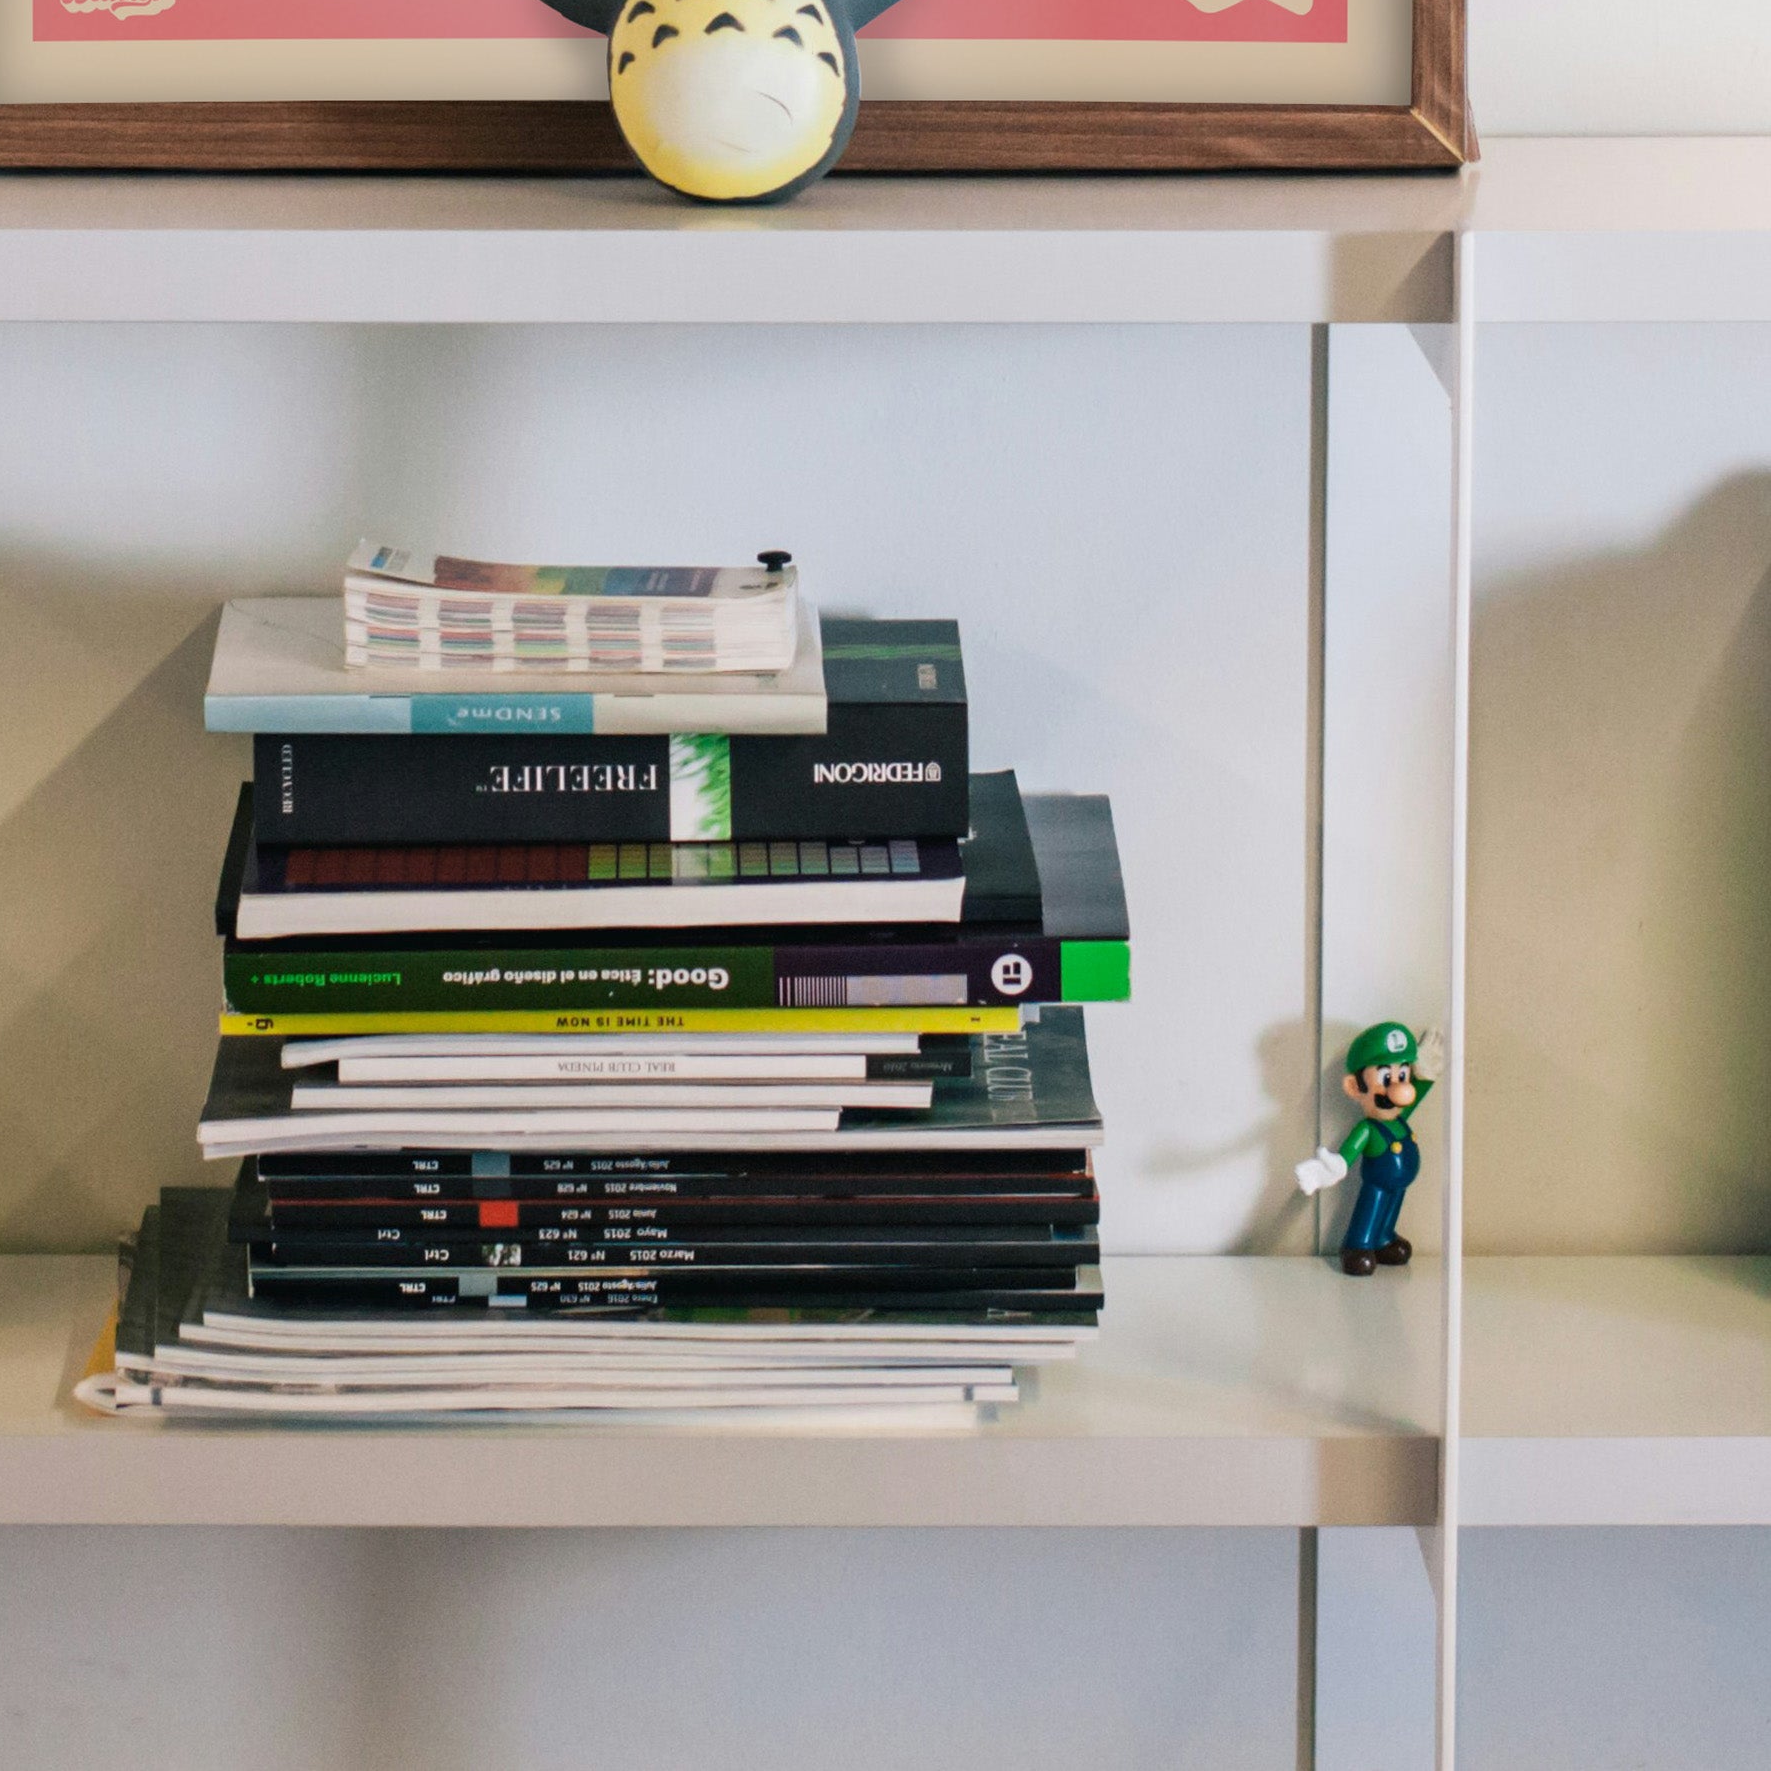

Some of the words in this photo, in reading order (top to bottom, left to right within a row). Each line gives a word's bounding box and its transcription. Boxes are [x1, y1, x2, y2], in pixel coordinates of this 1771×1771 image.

[814, 762, 924, 784] FEDRIGONI
[264, 972, 325, 986] Roberts
[330, 971, 401, 986] Lucienne
[443, 970, 501, 985] gráfico
[504, 969, 557, 985] diseño
[560, 970, 575, 983] el
[578, 971, 598, 981] en
[601, 969, 642, 986] Ética
[647, 968, 729, 989] Good:
[556, 1017, 591, 1028] NOW
[596, 1017, 609, 1027] IS
[618, 1017, 649, 1027] TIME
[657, 1016, 684, 1027] THE
[984, 1033, 1028, 1064] EAL
[558, 1062, 605, 1073] PINEDA
[609, 1062, 641, 1072] CLUB
[644, 1062, 676, 1072] REAL
[413, 1160, 439, 1171] CTRL
[591, 1160, 613, 1170] 2015
[414, 1184, 440, 1194] CTRL
[605, 1183, 627, 1193] 2015
[629, 1182, 678, 1193] Noviembre
[420, 1209, 447, 1220] CTRL
[608, 1209, 630, 1220] 2015
[378, 1229, 400, 1240] Ctrl
[538, 1229, 560, 1240] 623
[603, 1228, 631, 1239] 2015
[636, 1226, 668, 1238] Mayo
[425, 1250, 450, 1261] Ctrl
[567, 1250, 588, 1261] 621
[629, 1250, 657, 1261] 2015
[659, 1250, 695, 1261] Marzo
[399, 1282, 426, 1294] CTRL
[531, 1281, 549, 1291] 625
[578, 1281, 601, 1291] 2015
